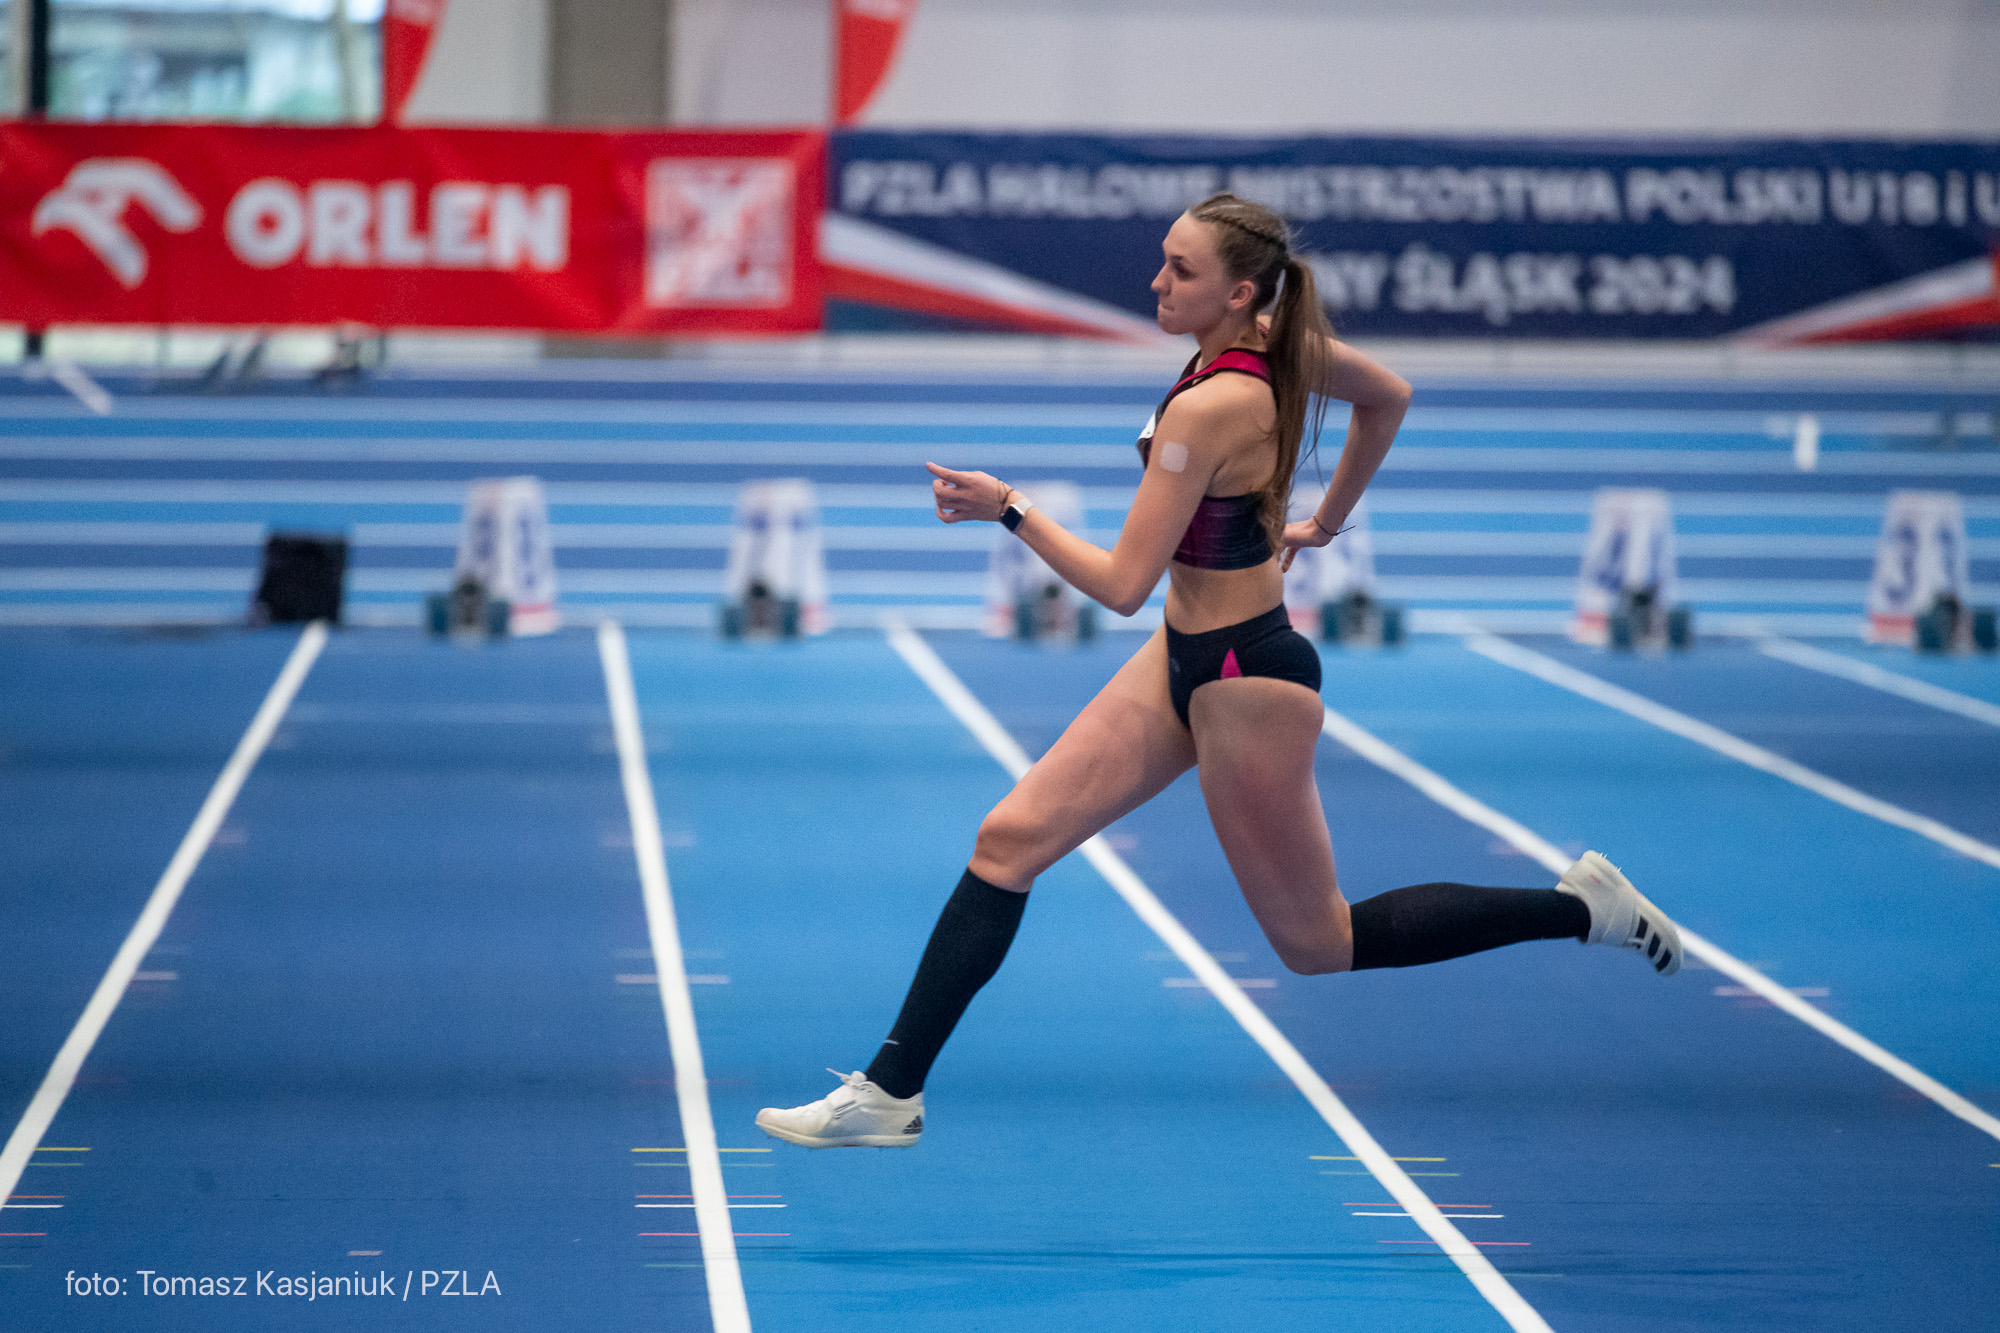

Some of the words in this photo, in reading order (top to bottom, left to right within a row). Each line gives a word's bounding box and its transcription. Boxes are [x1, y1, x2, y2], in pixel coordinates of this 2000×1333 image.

[226, 177, 570, 270] ORLEN
[842, 161, 985, 217] PZLA
[1626, 166, 1822, 225] POLSKI
[1588, 253, 1736, 313] 2024
